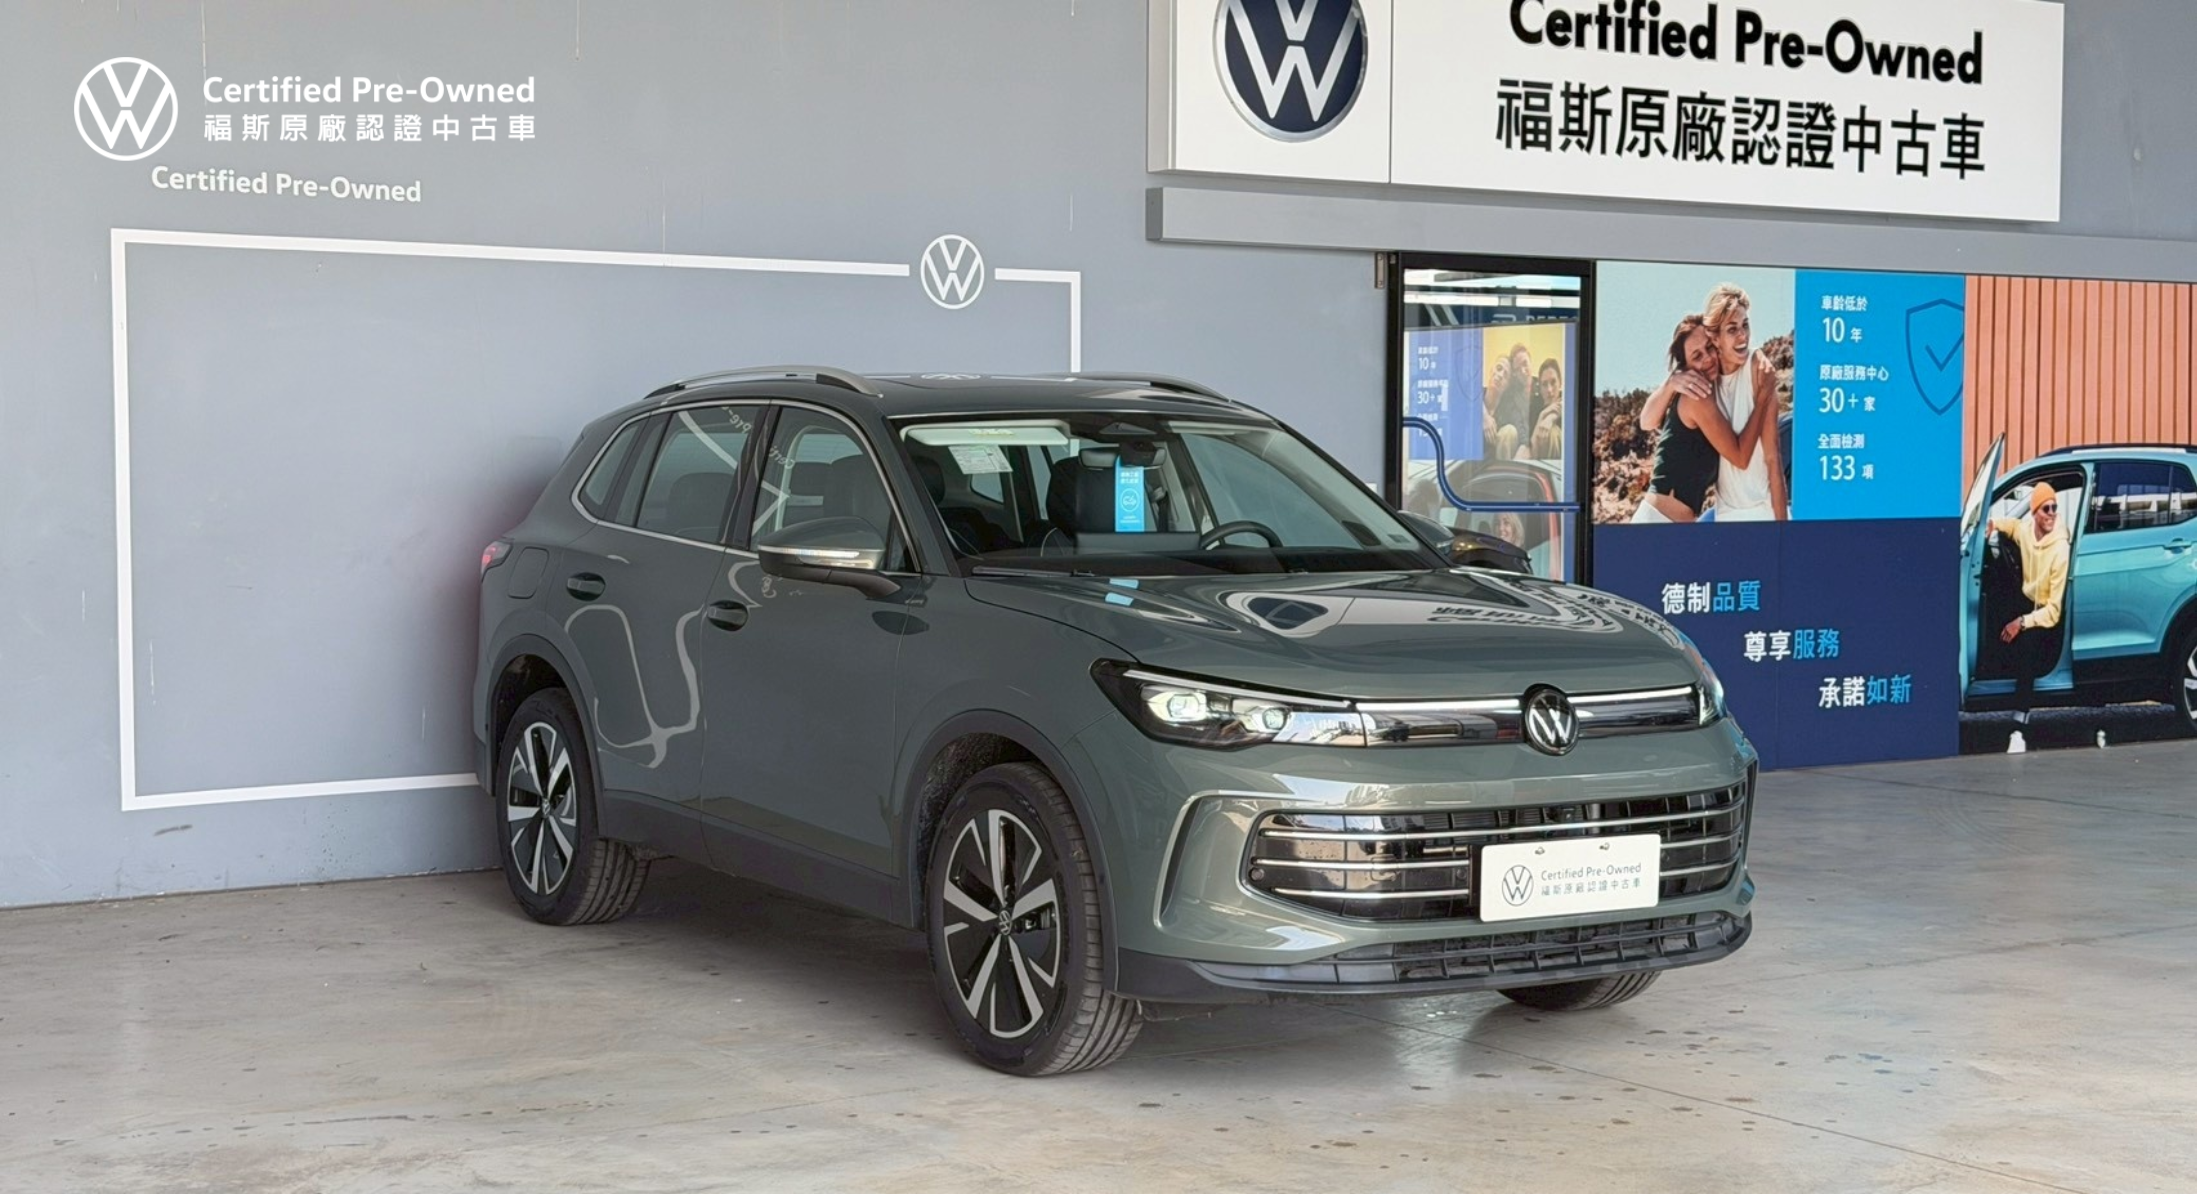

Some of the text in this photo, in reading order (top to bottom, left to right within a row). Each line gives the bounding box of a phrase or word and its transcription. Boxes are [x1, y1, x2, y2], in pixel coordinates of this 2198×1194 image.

[1510, 0, 1983, 84] Certified Pre-Owned
[1496, 78, 1985, 180] 福斯原廠認證中古車
[151, 165, 421, 203] Certified Pre-Owned
[1821, 295, 1868, 312] 車齡低於
[1822, 317, 1863, 343] 10 年
[1819, 364, 1889, 381] 原廠服務中心
[1863, 395, 1876, 412] 家
[1818, 433, 1865, 449] 全面檢測
[1820, 455, 1874, 481] 133 項
[1661, 580, 1761, 615] 德制品質
[1743, 628, 1840, 662] 尊享服務
[1818, 674, 1912, 709] 承諾如新
[1541, 862, 1642, 881] Certified Pre-Owned
